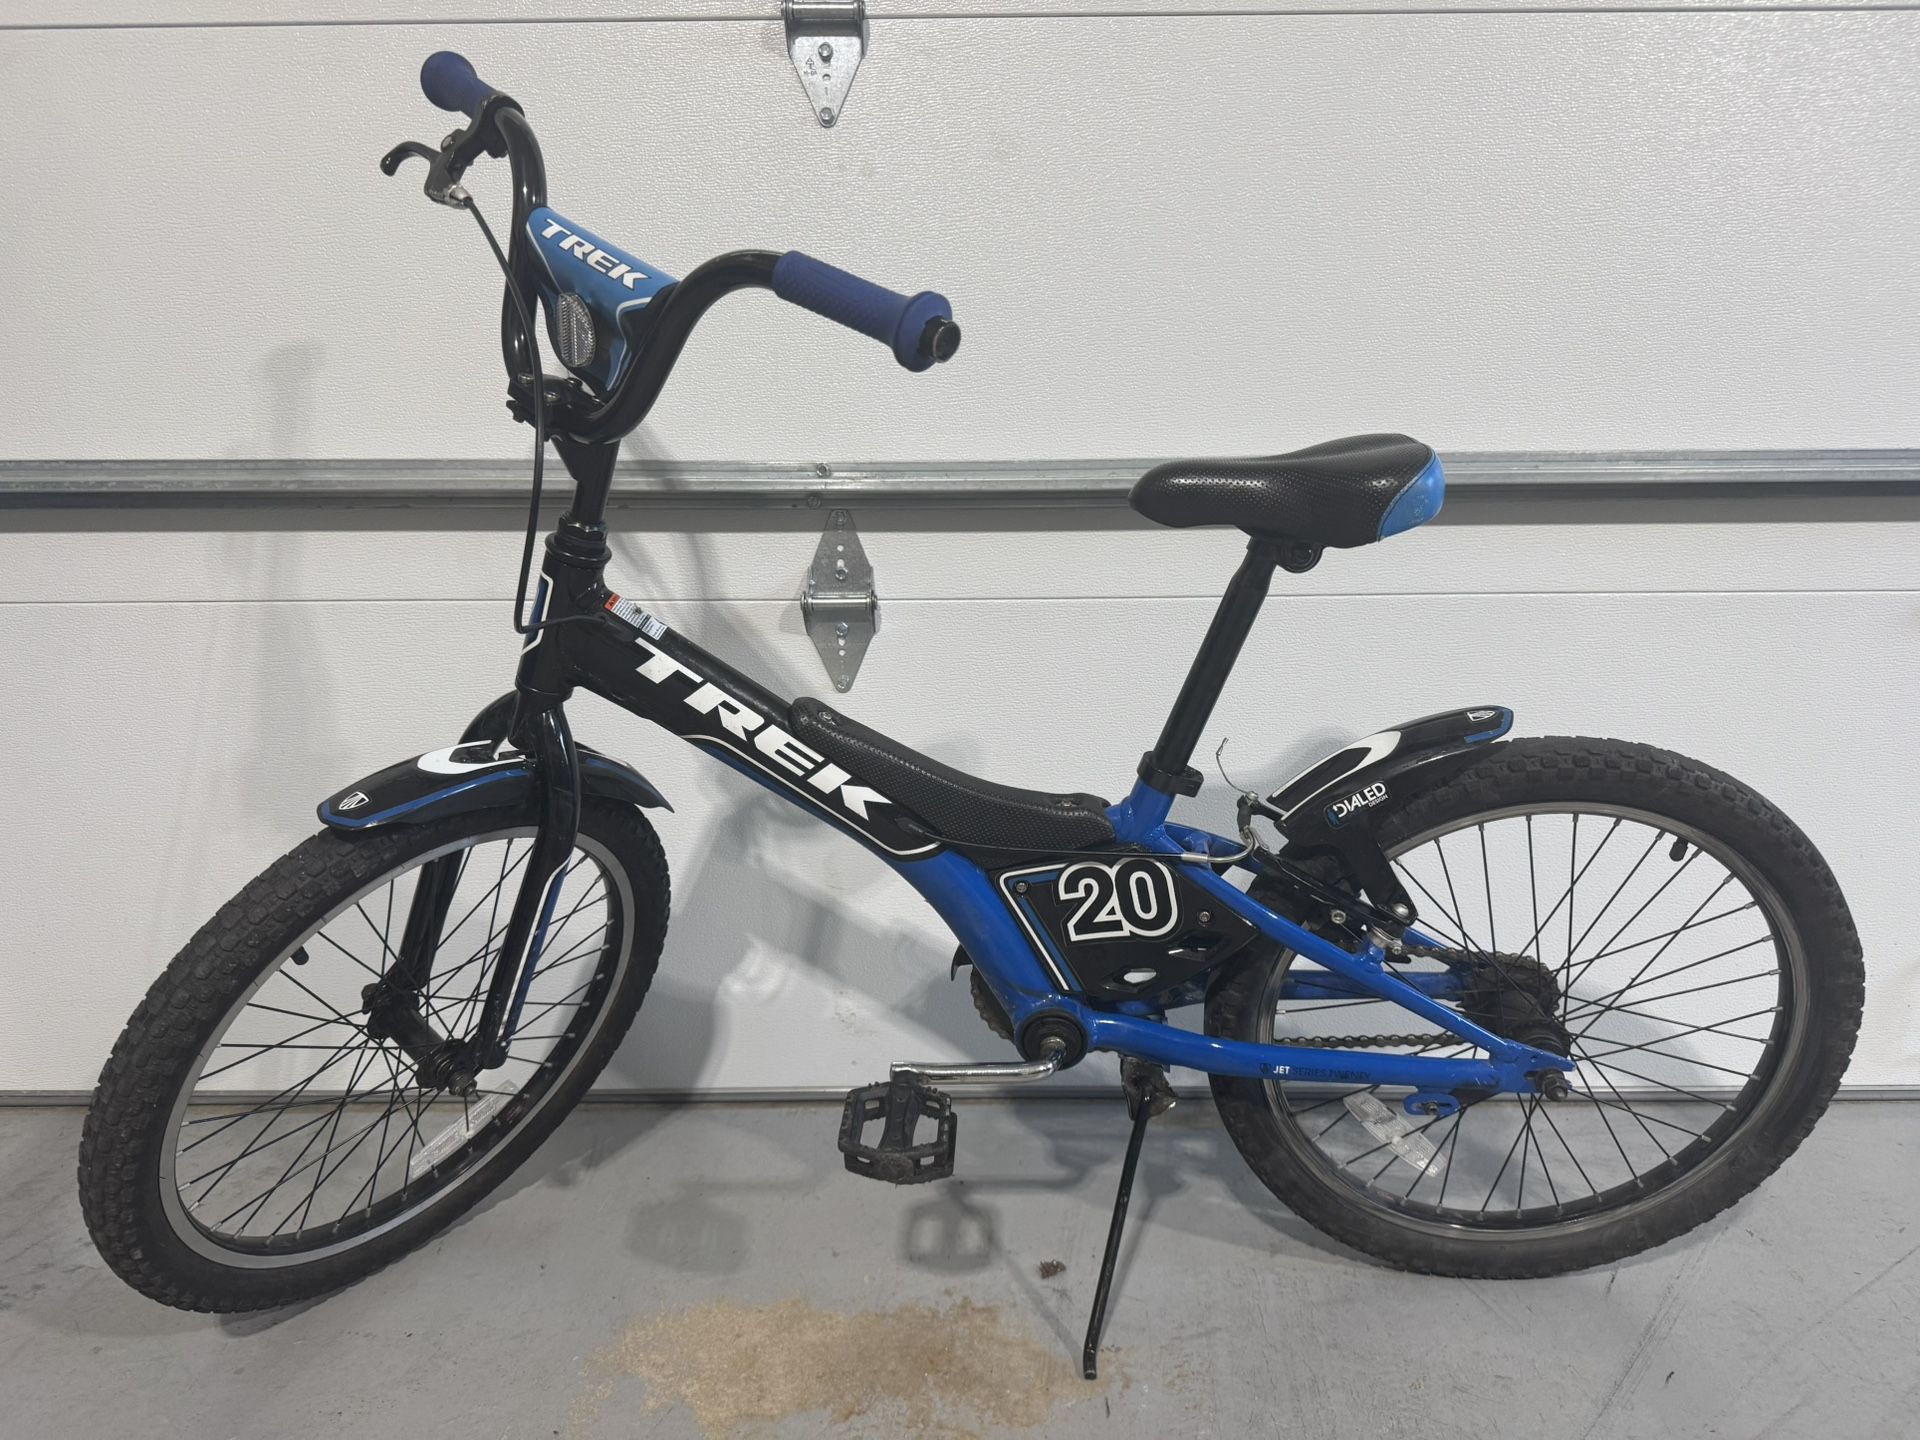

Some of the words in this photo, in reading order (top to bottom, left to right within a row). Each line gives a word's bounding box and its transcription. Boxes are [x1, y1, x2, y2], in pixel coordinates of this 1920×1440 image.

[542, 218, 649, 290] TREK
[635, 637, 893, 821] TREK
[1332, 782, 1386, 818] DIALED
[1058, 857, 1179, 942] 20
[1273, 1065, 1290, 1075] JET
